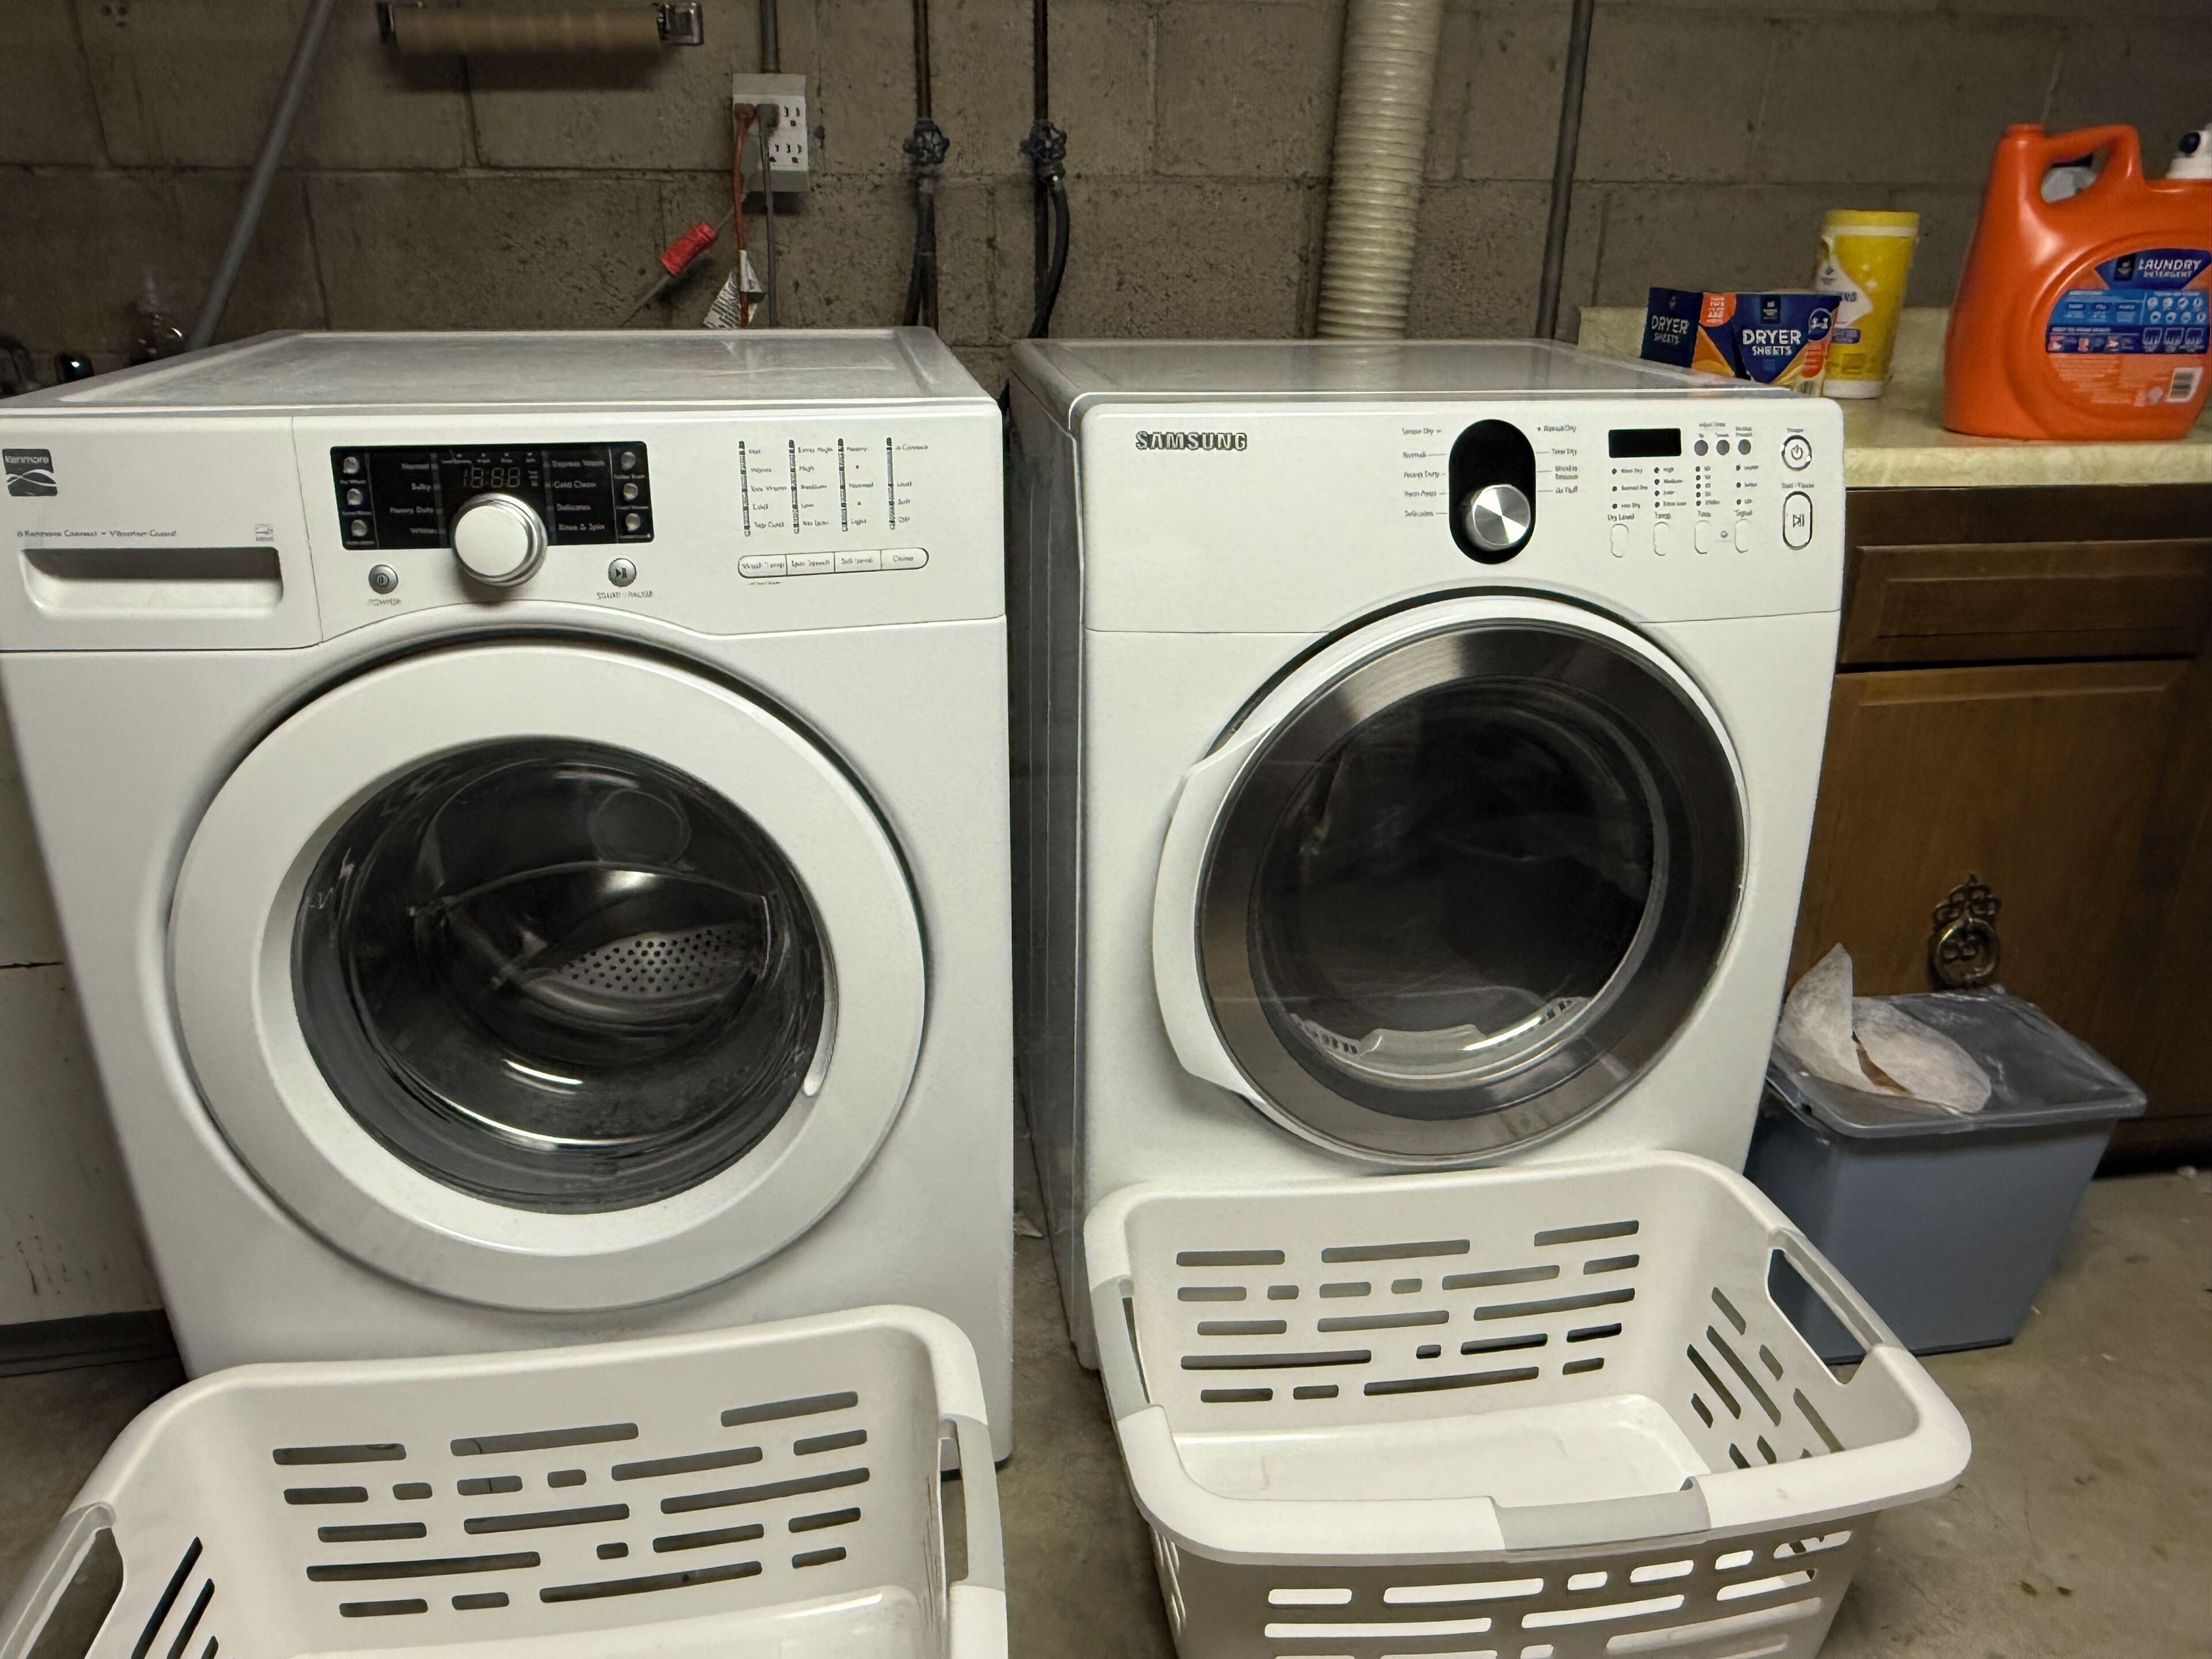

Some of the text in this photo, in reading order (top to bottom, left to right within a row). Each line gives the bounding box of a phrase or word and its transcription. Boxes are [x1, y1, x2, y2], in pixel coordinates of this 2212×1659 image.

[2138, 259, 2202, 271] LAUNDRY
[2143, 270, 2192, 278] DETERGENT
[1651, 315, 1690, 335] DRYER
[1743, 329, 1802, 346] DRYER
[1752, 346, 1792, 356] SHEETS
[1135, 431, 1247, 451] SAMSUNG
